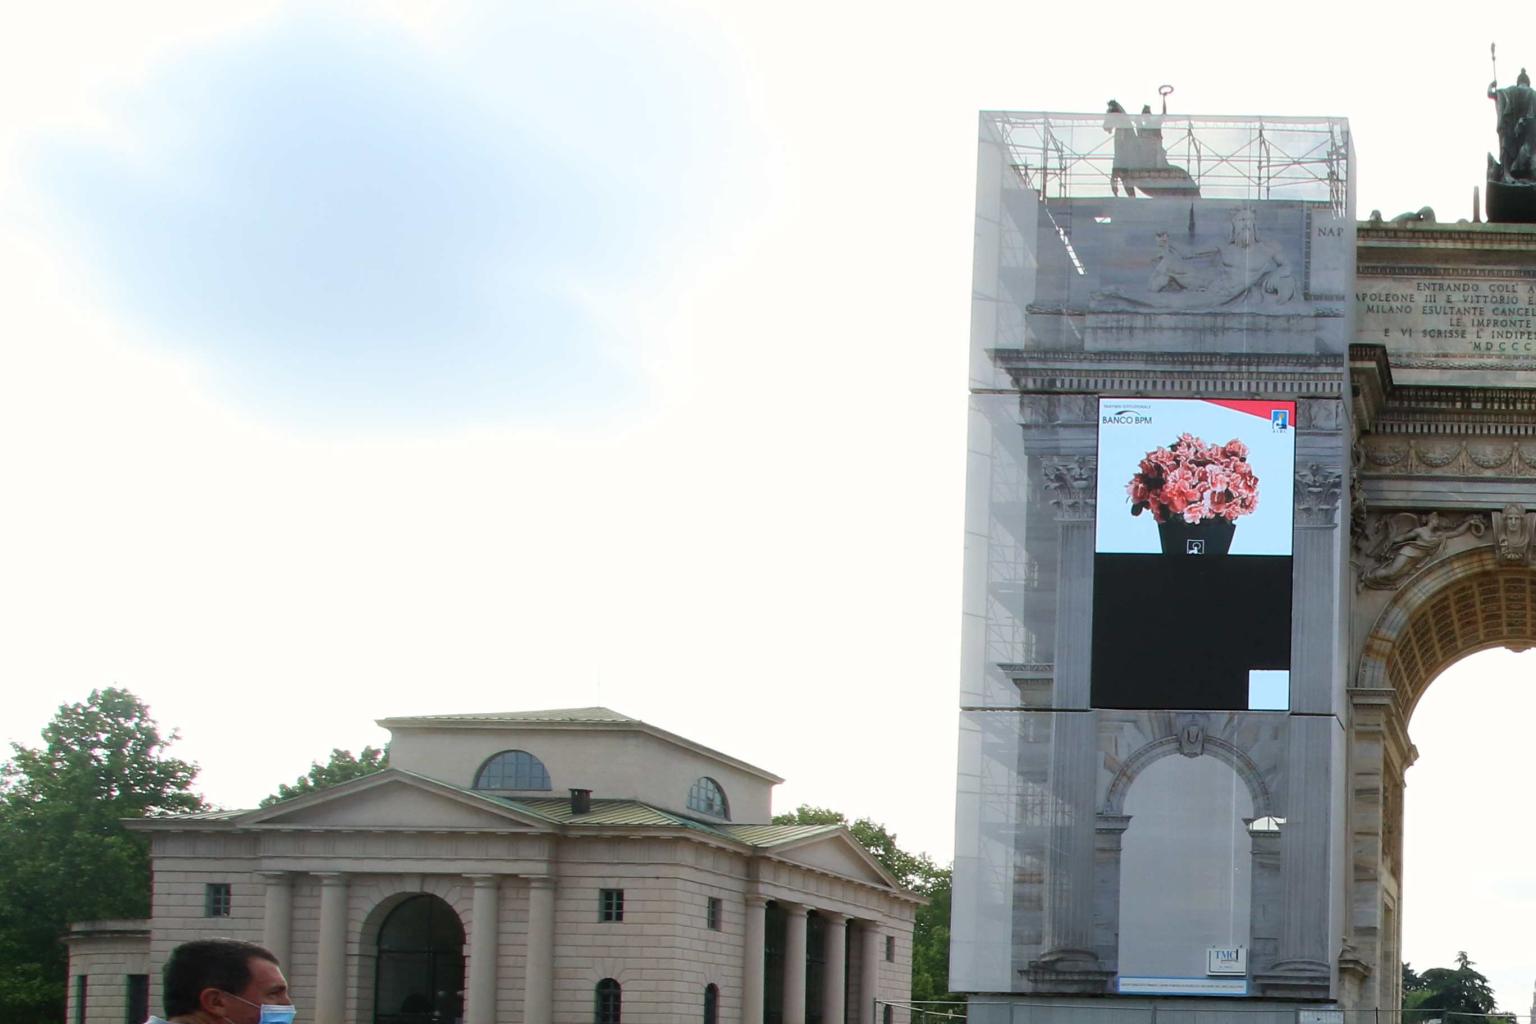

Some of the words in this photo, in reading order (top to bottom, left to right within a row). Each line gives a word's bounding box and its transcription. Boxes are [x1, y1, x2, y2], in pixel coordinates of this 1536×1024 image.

[1416, 282, 1479, 292] ENTRANDO
[1424, 294, 1437, 303] III
[1445, 294, 1453, 304] E
[1463, 295, 1519, 304] VITTORIO
[1366, 305, 1413, 314] MILANO
[1422, 306, 1485, 316] ESULTANTE
[1449, 318, 1461, 327] LE
[1471, 318, 1532, 329] IMPRONTE
[1384, 328, 1390, 337] E
[1401, 328, 1413, 338] VI
[1422, 329, 1467, 339] SCRISSE
[1102, 415, 1133, 425] BANCO
[1134, 416, 1152, 425] BPM
